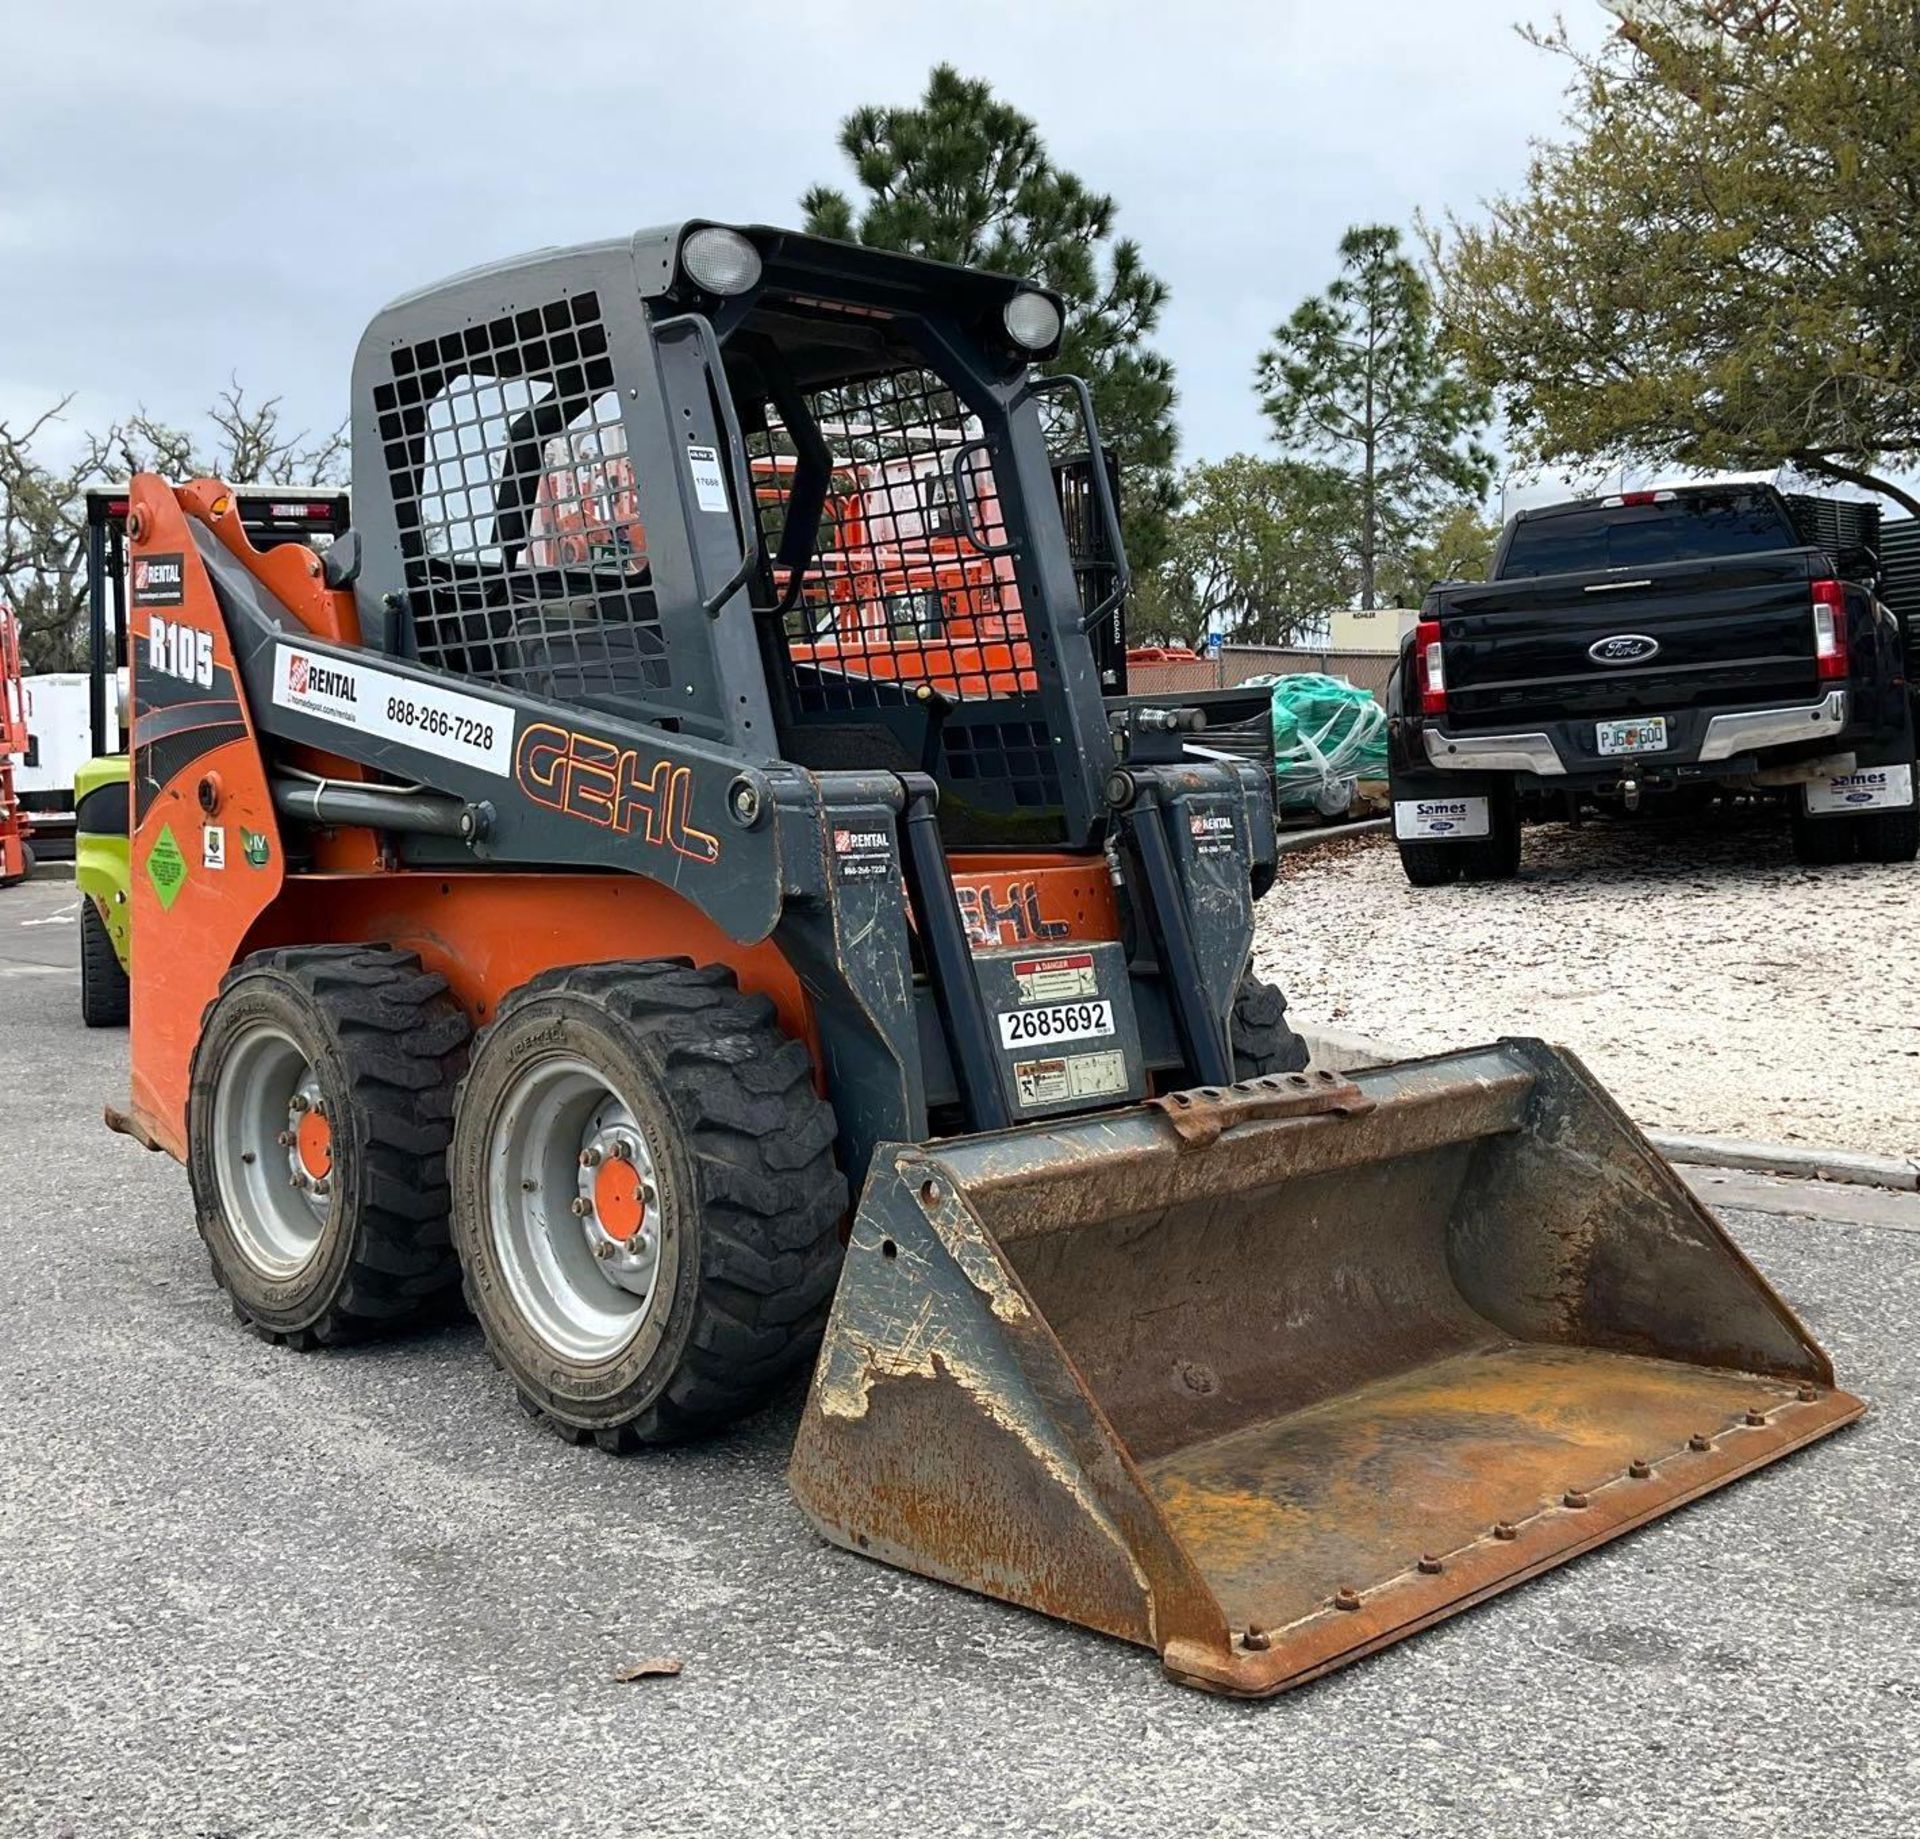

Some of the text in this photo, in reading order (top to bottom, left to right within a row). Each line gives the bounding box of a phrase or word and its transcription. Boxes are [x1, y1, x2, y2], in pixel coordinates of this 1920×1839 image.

[148, 564, 181, 583] RENTAL
[1113, 608, 1121, 645] TOYOTA
[149, 613, 213, 690] R105
[1605, 640, 1643, 657] Ford
[309, 666, 357, 702] RENTAL
[387, 697, 494, 750] 888-266-7228
[516, 722, 719, 864] GEHL
[1417, 803, 1467, 815] Sames
[1203, 817, 1233, 829] RENTAL
[850, 833, 889, 848] RENTAL
[1041, 959, 1069, 970] DANGER
[1008, 1003, 1107, 1040] 2685692
